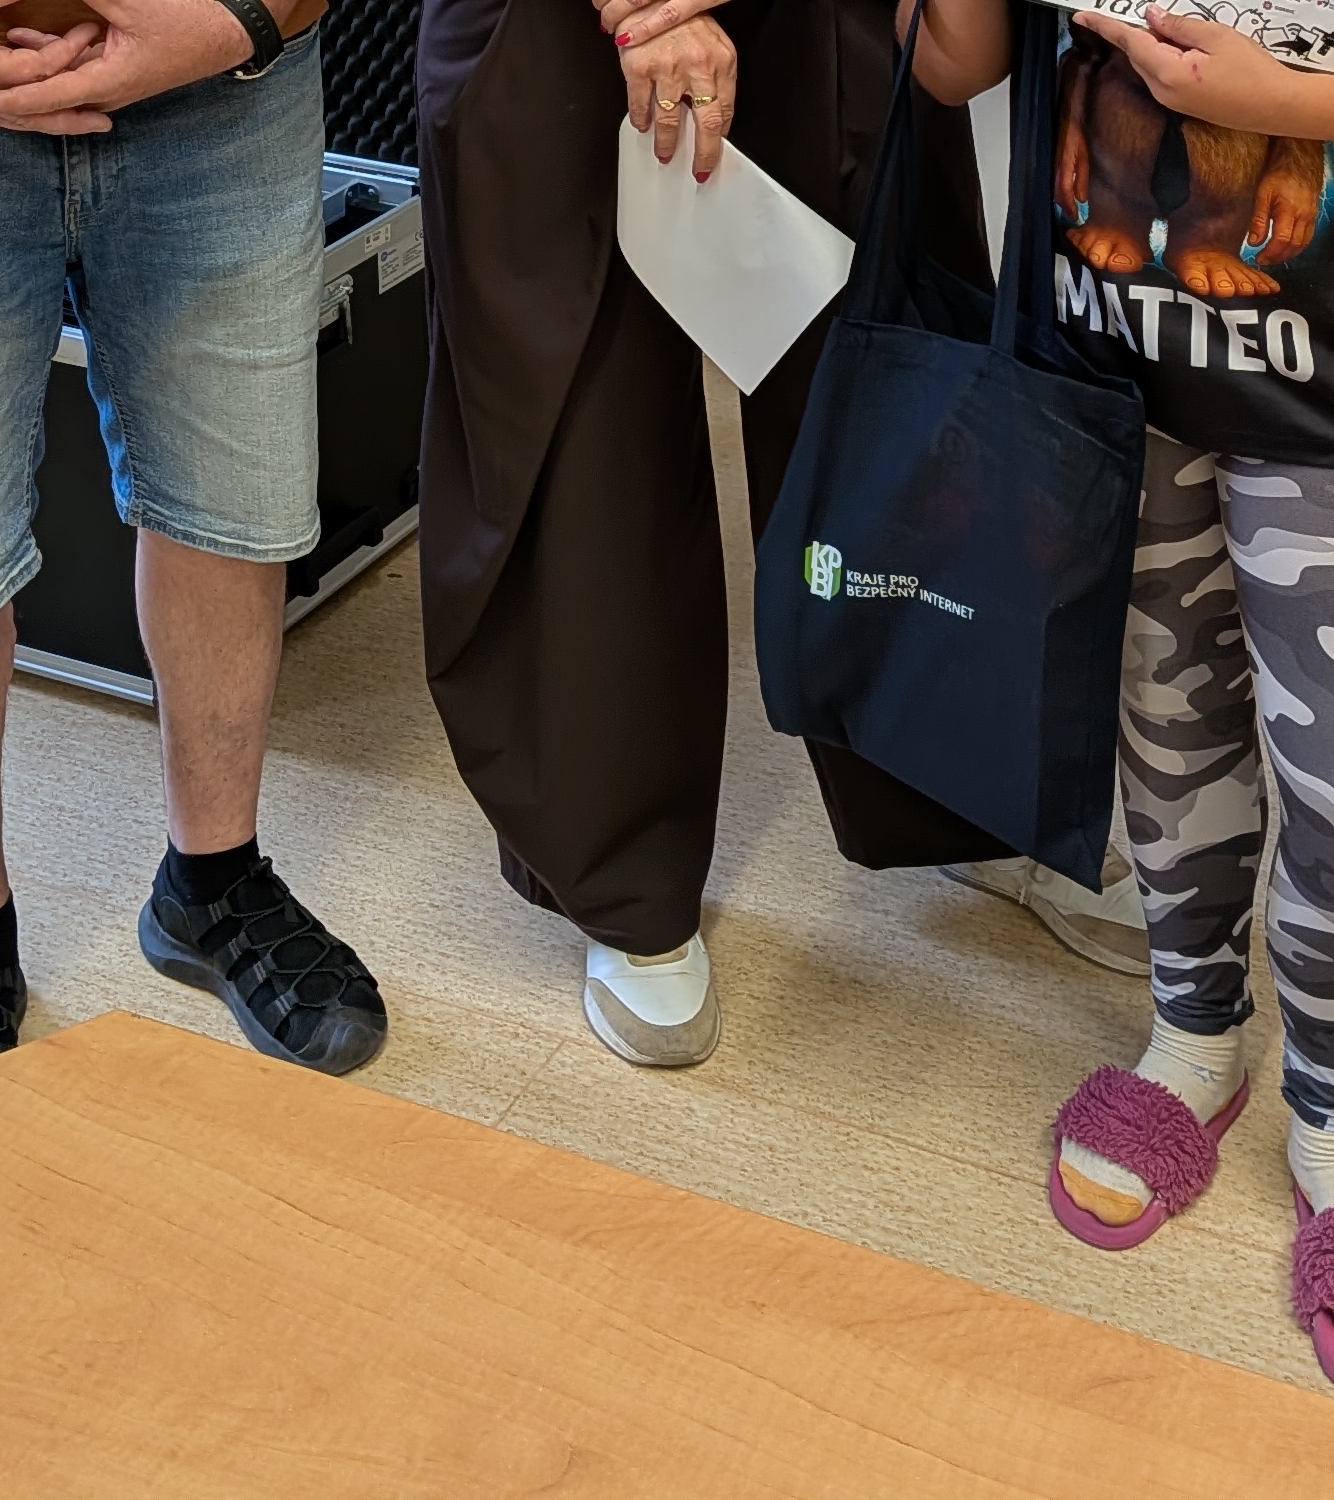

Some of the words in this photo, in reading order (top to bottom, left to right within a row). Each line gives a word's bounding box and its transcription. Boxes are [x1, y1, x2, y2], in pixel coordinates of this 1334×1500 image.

[1054, 252, 1315, 383] MATTEO
[810, 540, 842, 572] KP
[846, 569, 886, 586] KRAJE
[889, 573, 919, 588] PRO
[846, 583, 917, 599] BEZPEČNÝ
[919, 589, 975, 621] INTERNET
